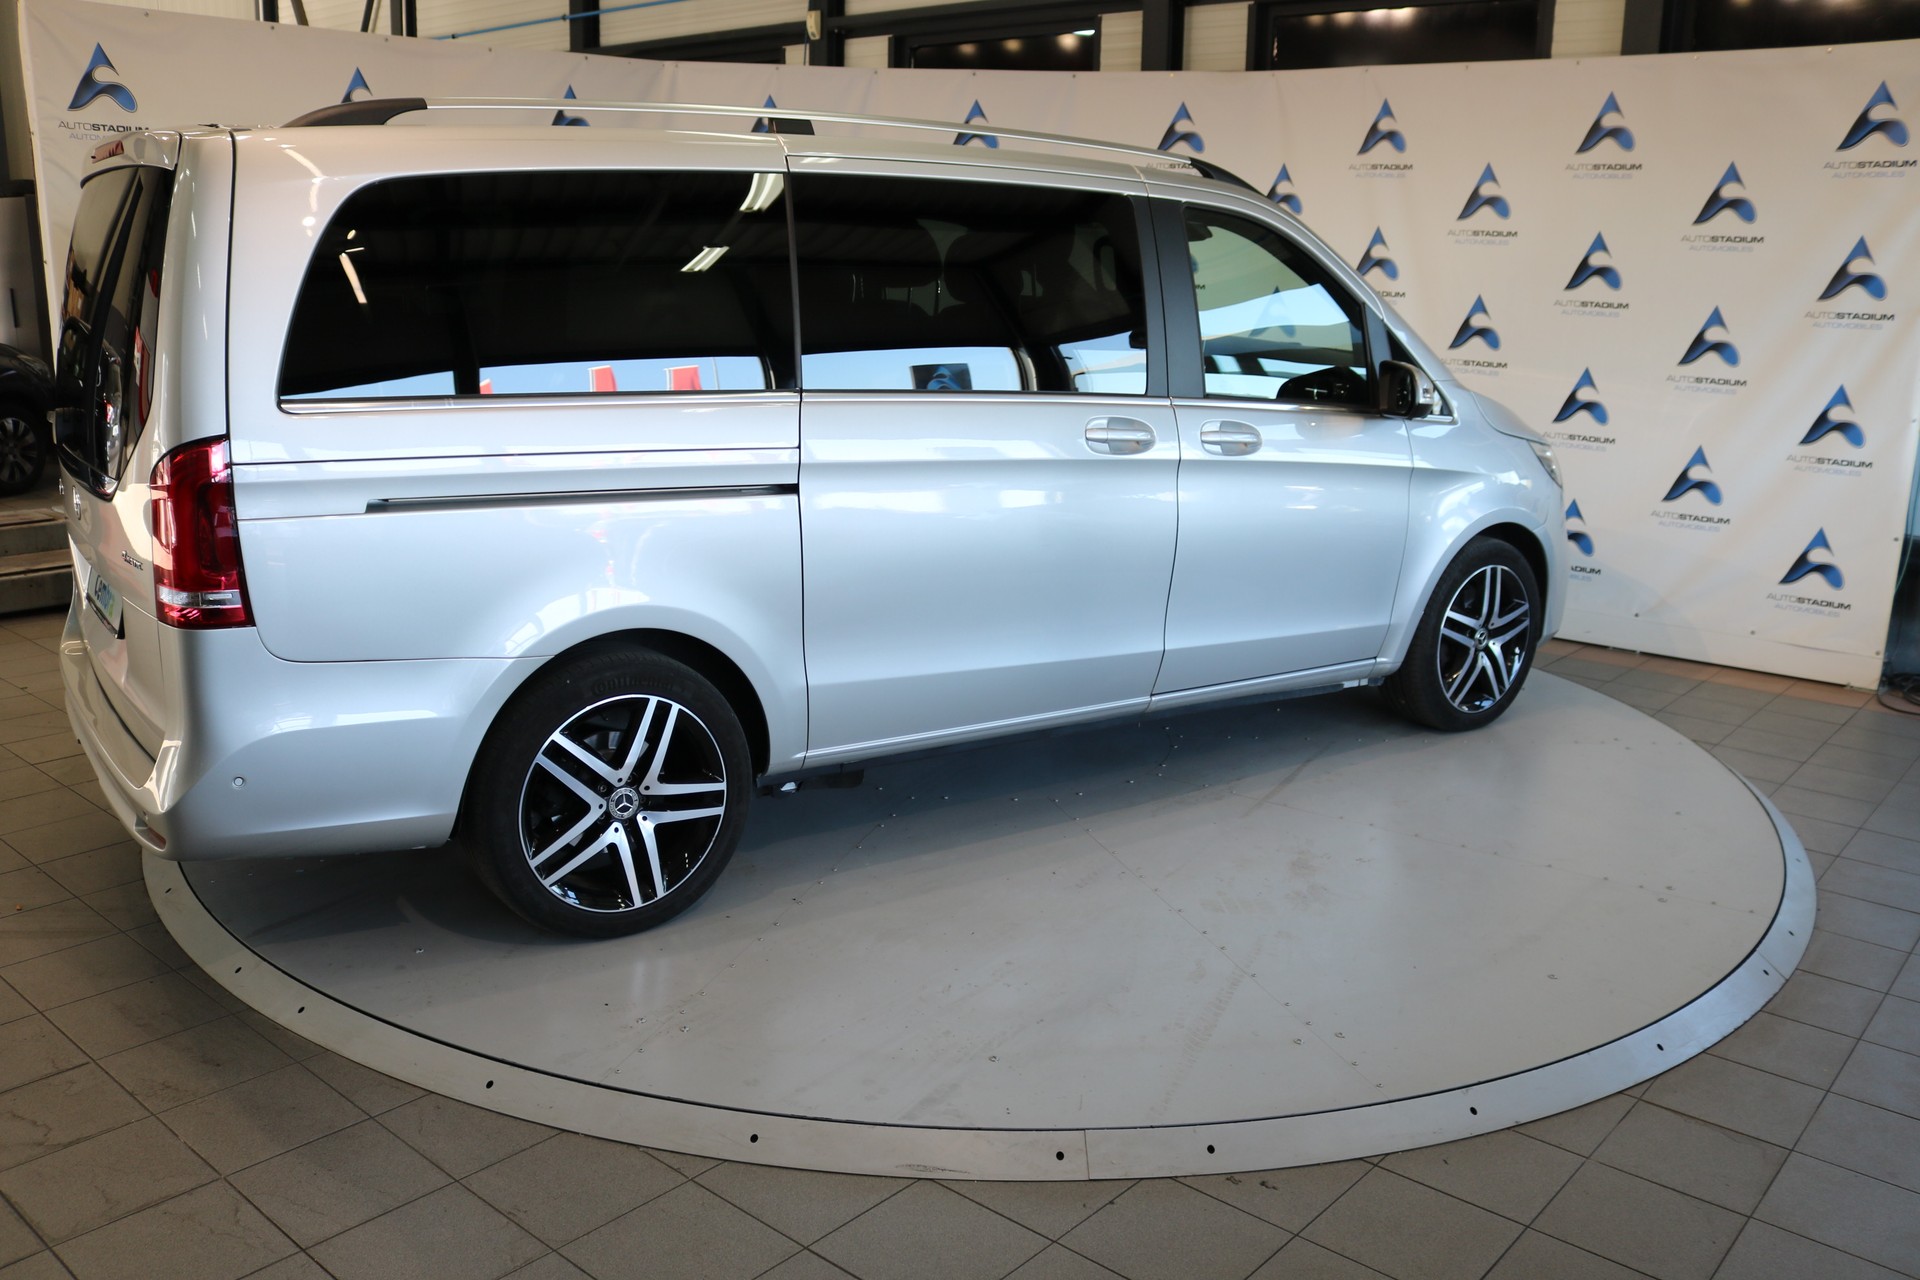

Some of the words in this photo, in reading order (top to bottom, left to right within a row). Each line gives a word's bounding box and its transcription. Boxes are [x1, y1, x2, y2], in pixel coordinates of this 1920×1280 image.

[1348, 163, 1413, 171] AUTOSTADIUM
[1565, 163, 1642, 171] AUTOSTADIUM
[1823, 160, 1918, 170] AUTOSTADIUM
[1447, 229, 1518, 238] AUTOSTADIUM
[1680, 234, 1765, 244] AUTOSTADIUM
[1553, 299, 1629, 310] AUTOSTADIUM
[1804, 310, 1895, 322] AUTOSTADIUM
[1665, 374, 1747, 387] AUTOSTADIUM
[1542, 431, 1616, 445] AUTOSTADIUM
[1786, 454, 1873, 469] AUTOSTADIUM
[1650, 510, 1731, 526] AUTOSTADIUM
[1766, 592, 1851, 611] AUTOSTADIUM
